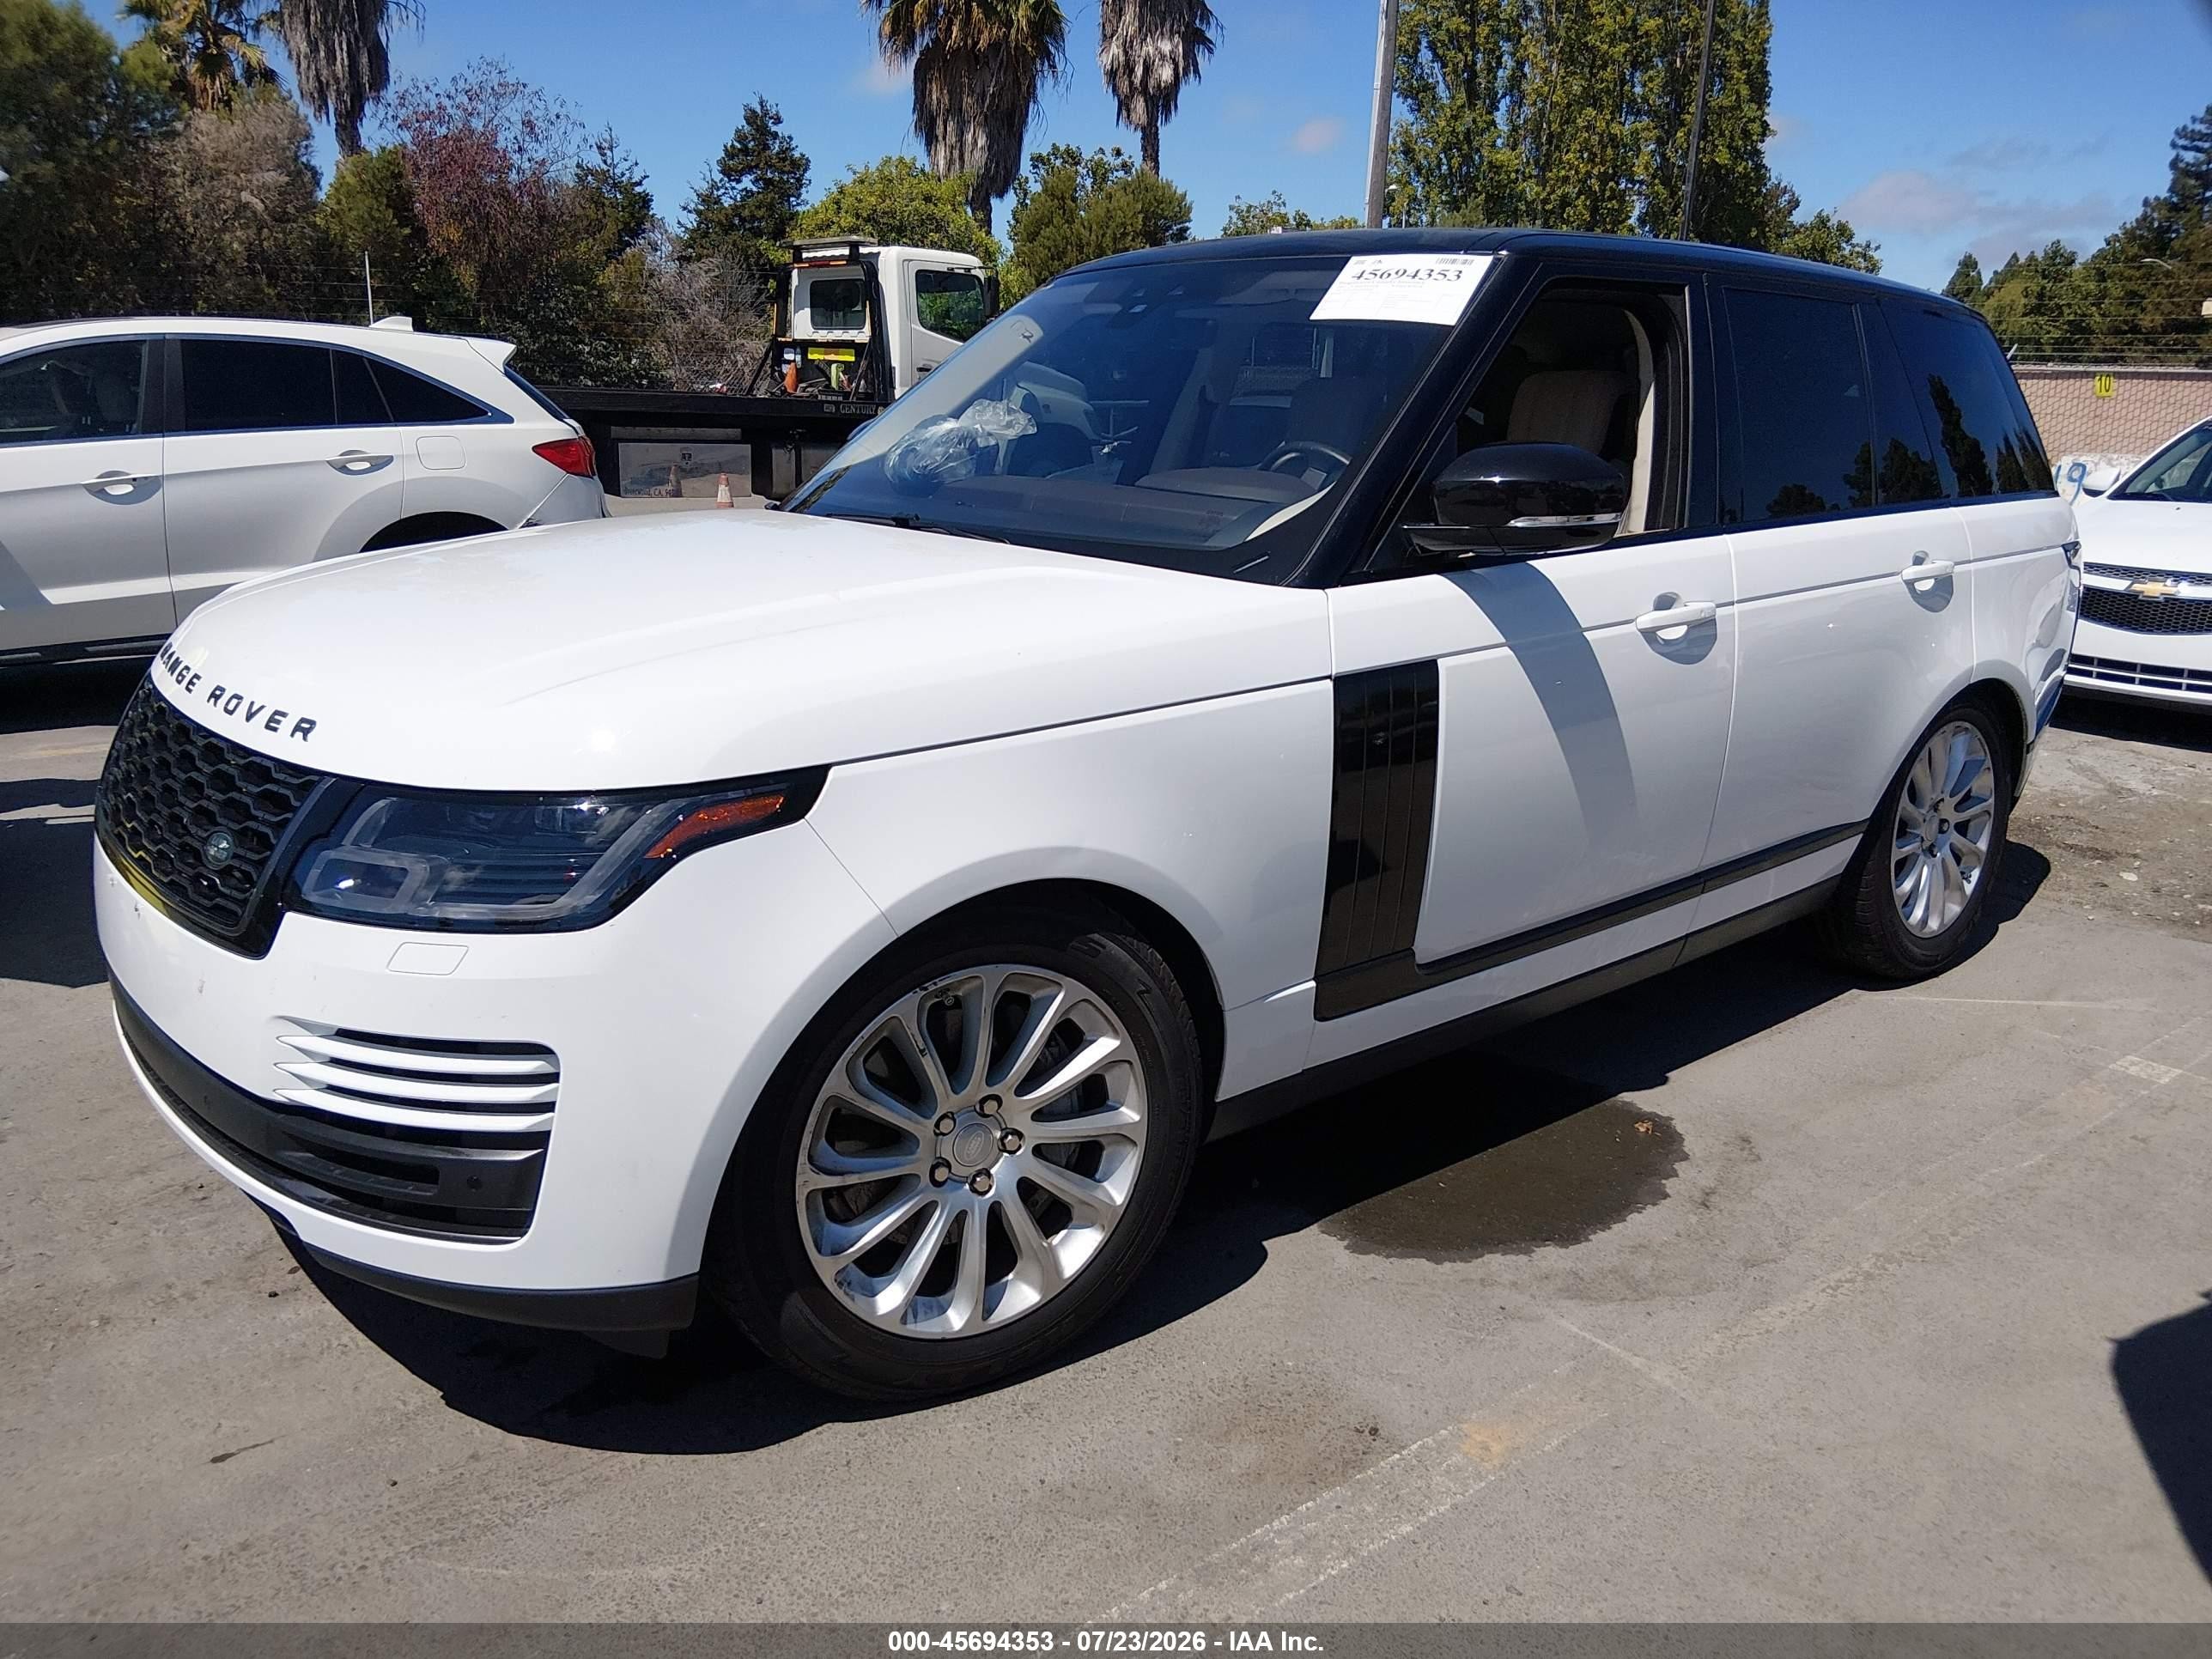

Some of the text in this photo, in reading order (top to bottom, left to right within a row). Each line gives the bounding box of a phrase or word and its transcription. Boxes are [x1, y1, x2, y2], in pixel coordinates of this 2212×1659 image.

[1351, 268, 1463, 282] 45694353
[2097, 374, 2112, 393] 10
[839, 404, 877, 415] CENTURY
[159, 641, 317, 743] RANGE ROVER
